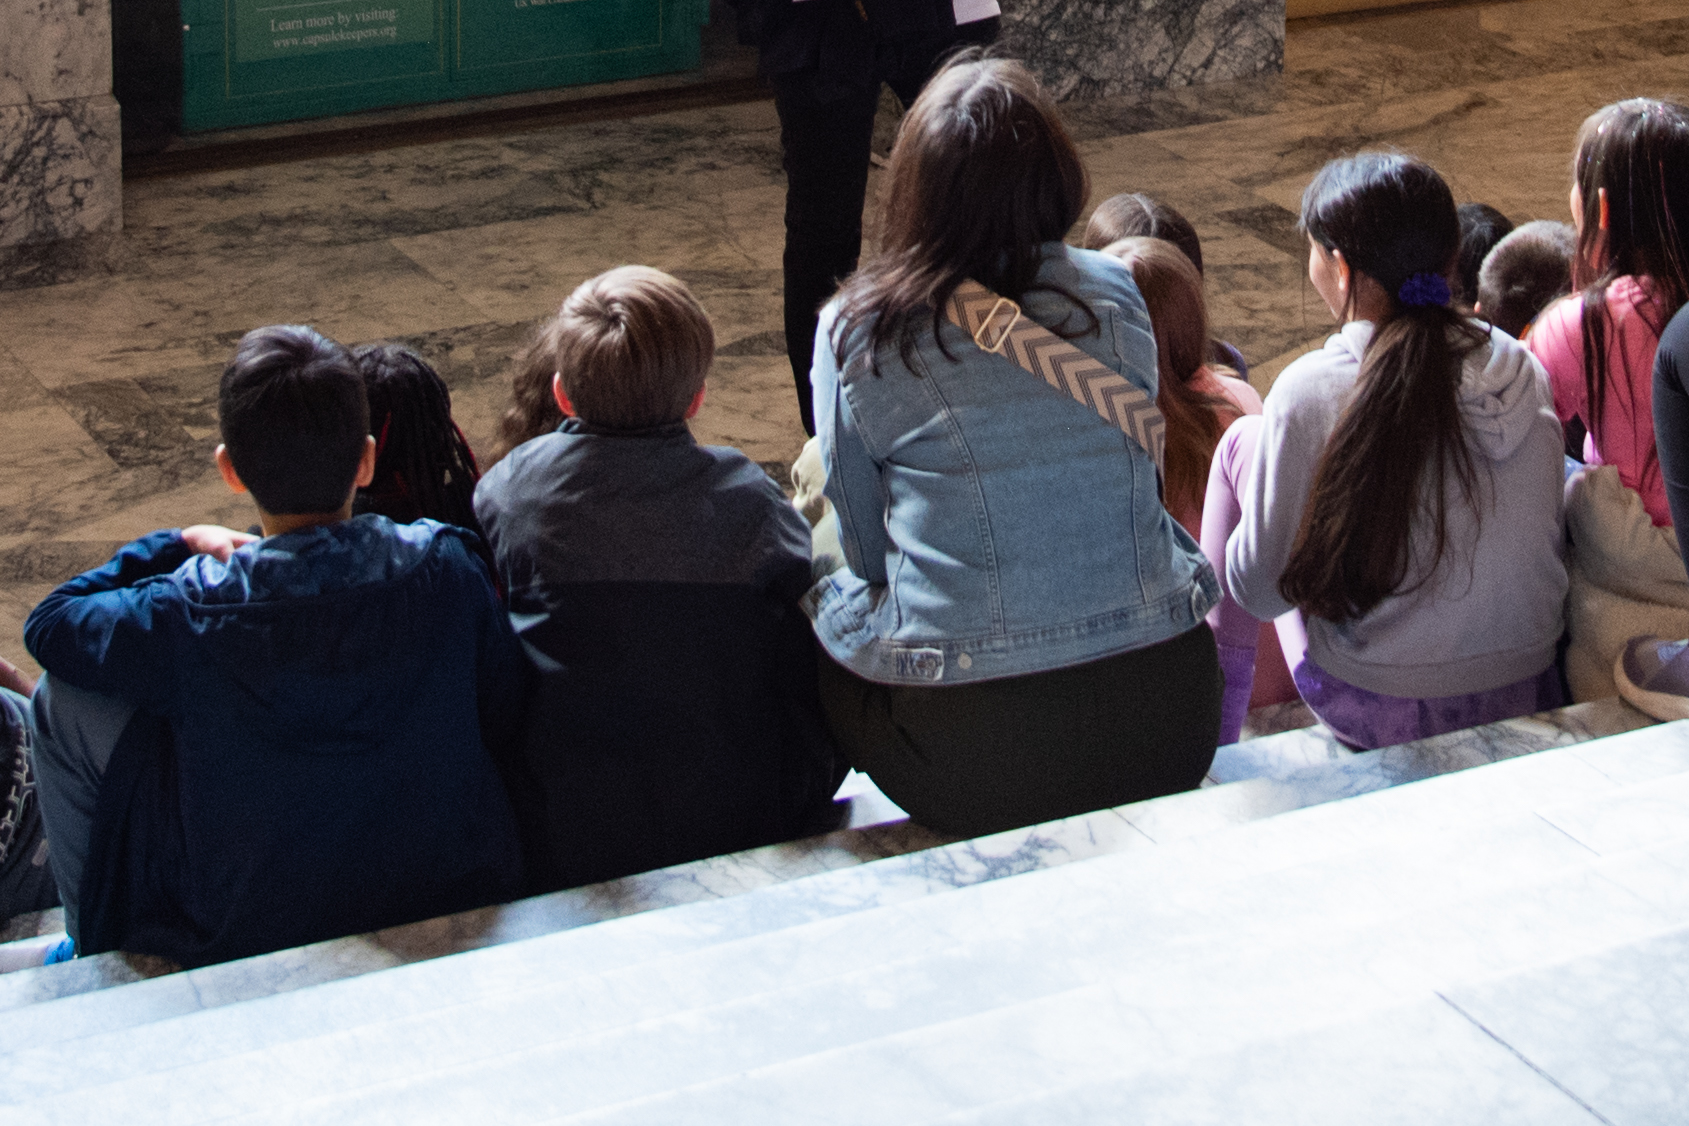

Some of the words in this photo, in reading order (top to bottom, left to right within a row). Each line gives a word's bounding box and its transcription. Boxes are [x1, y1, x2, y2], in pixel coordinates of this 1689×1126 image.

[271, 19, 303, 33] Learn
[306, 14, 335, 27] more
[337, 12, 351, 27] by
